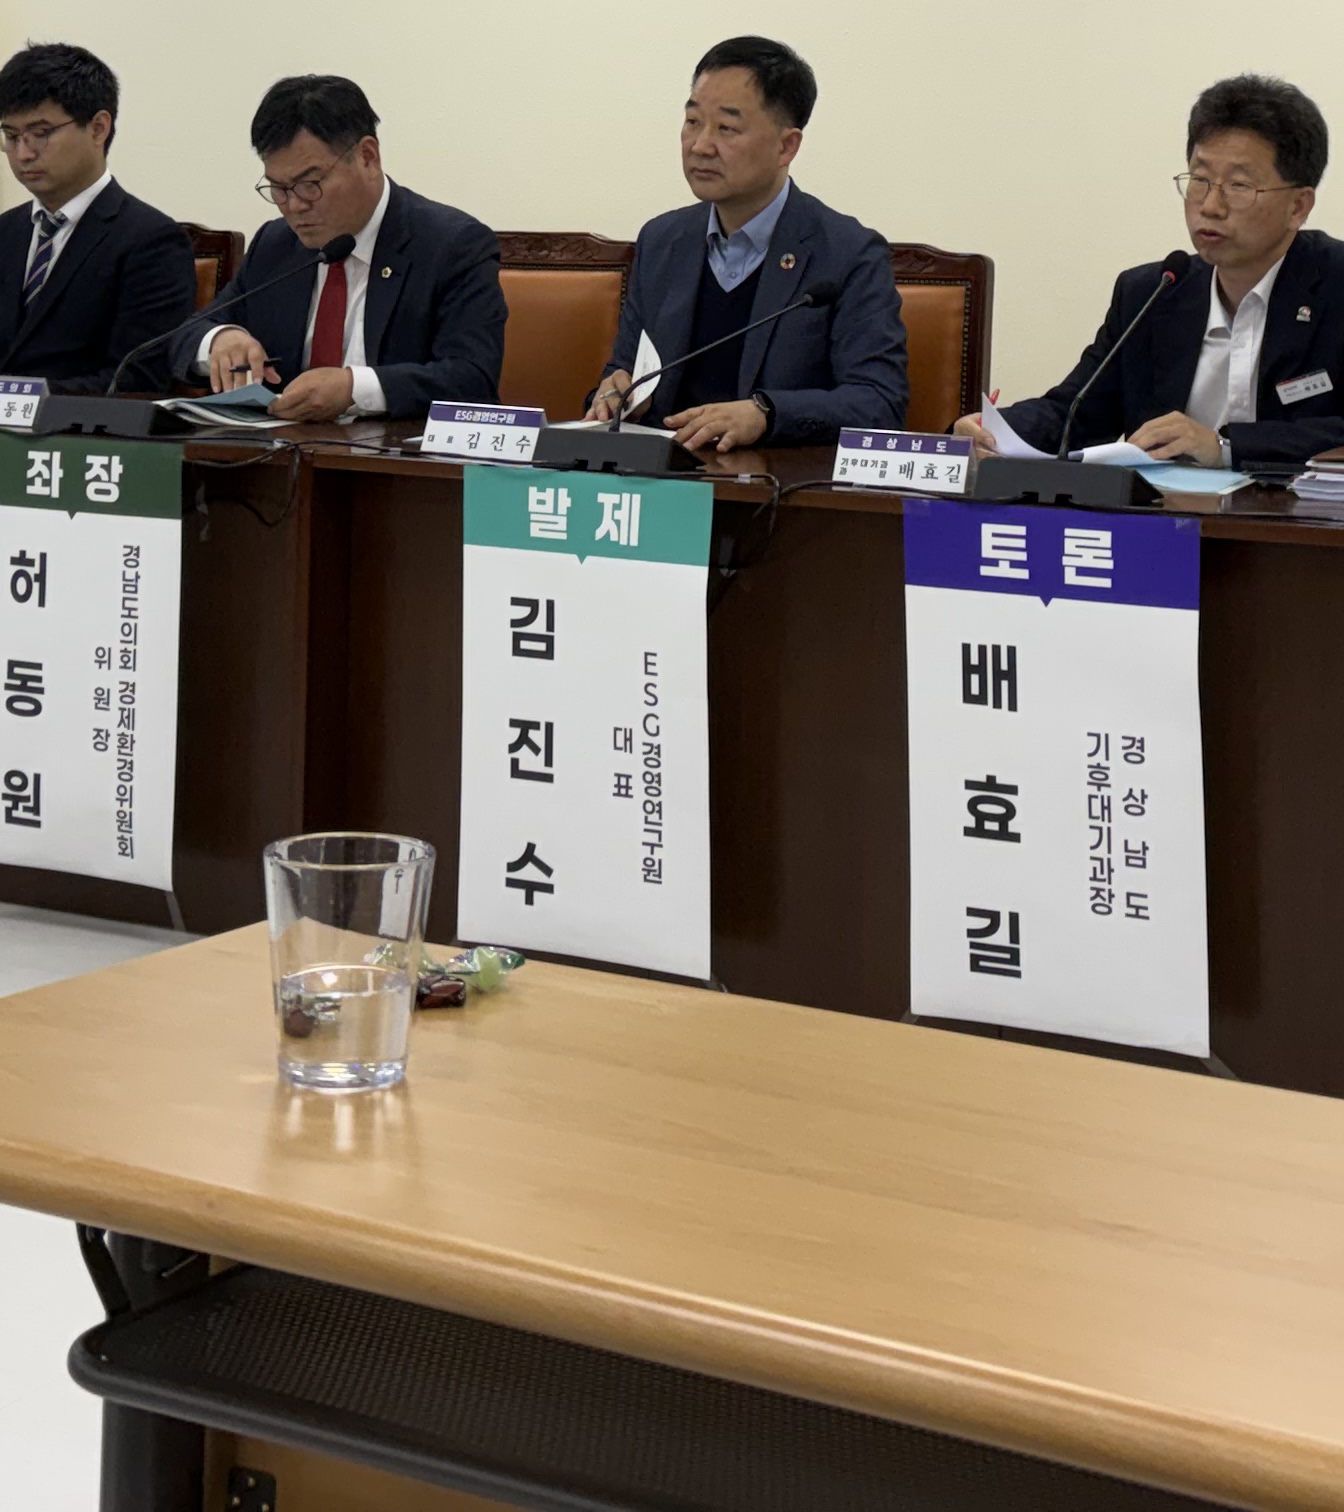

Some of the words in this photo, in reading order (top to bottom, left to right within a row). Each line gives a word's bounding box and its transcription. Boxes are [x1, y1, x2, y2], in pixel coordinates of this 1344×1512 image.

[119, 544, 141, 673] 경남도의회
[116, 680, 136, 859] 경제환경위원회
[1086, 731, 1115, 917] 기후대기과장
